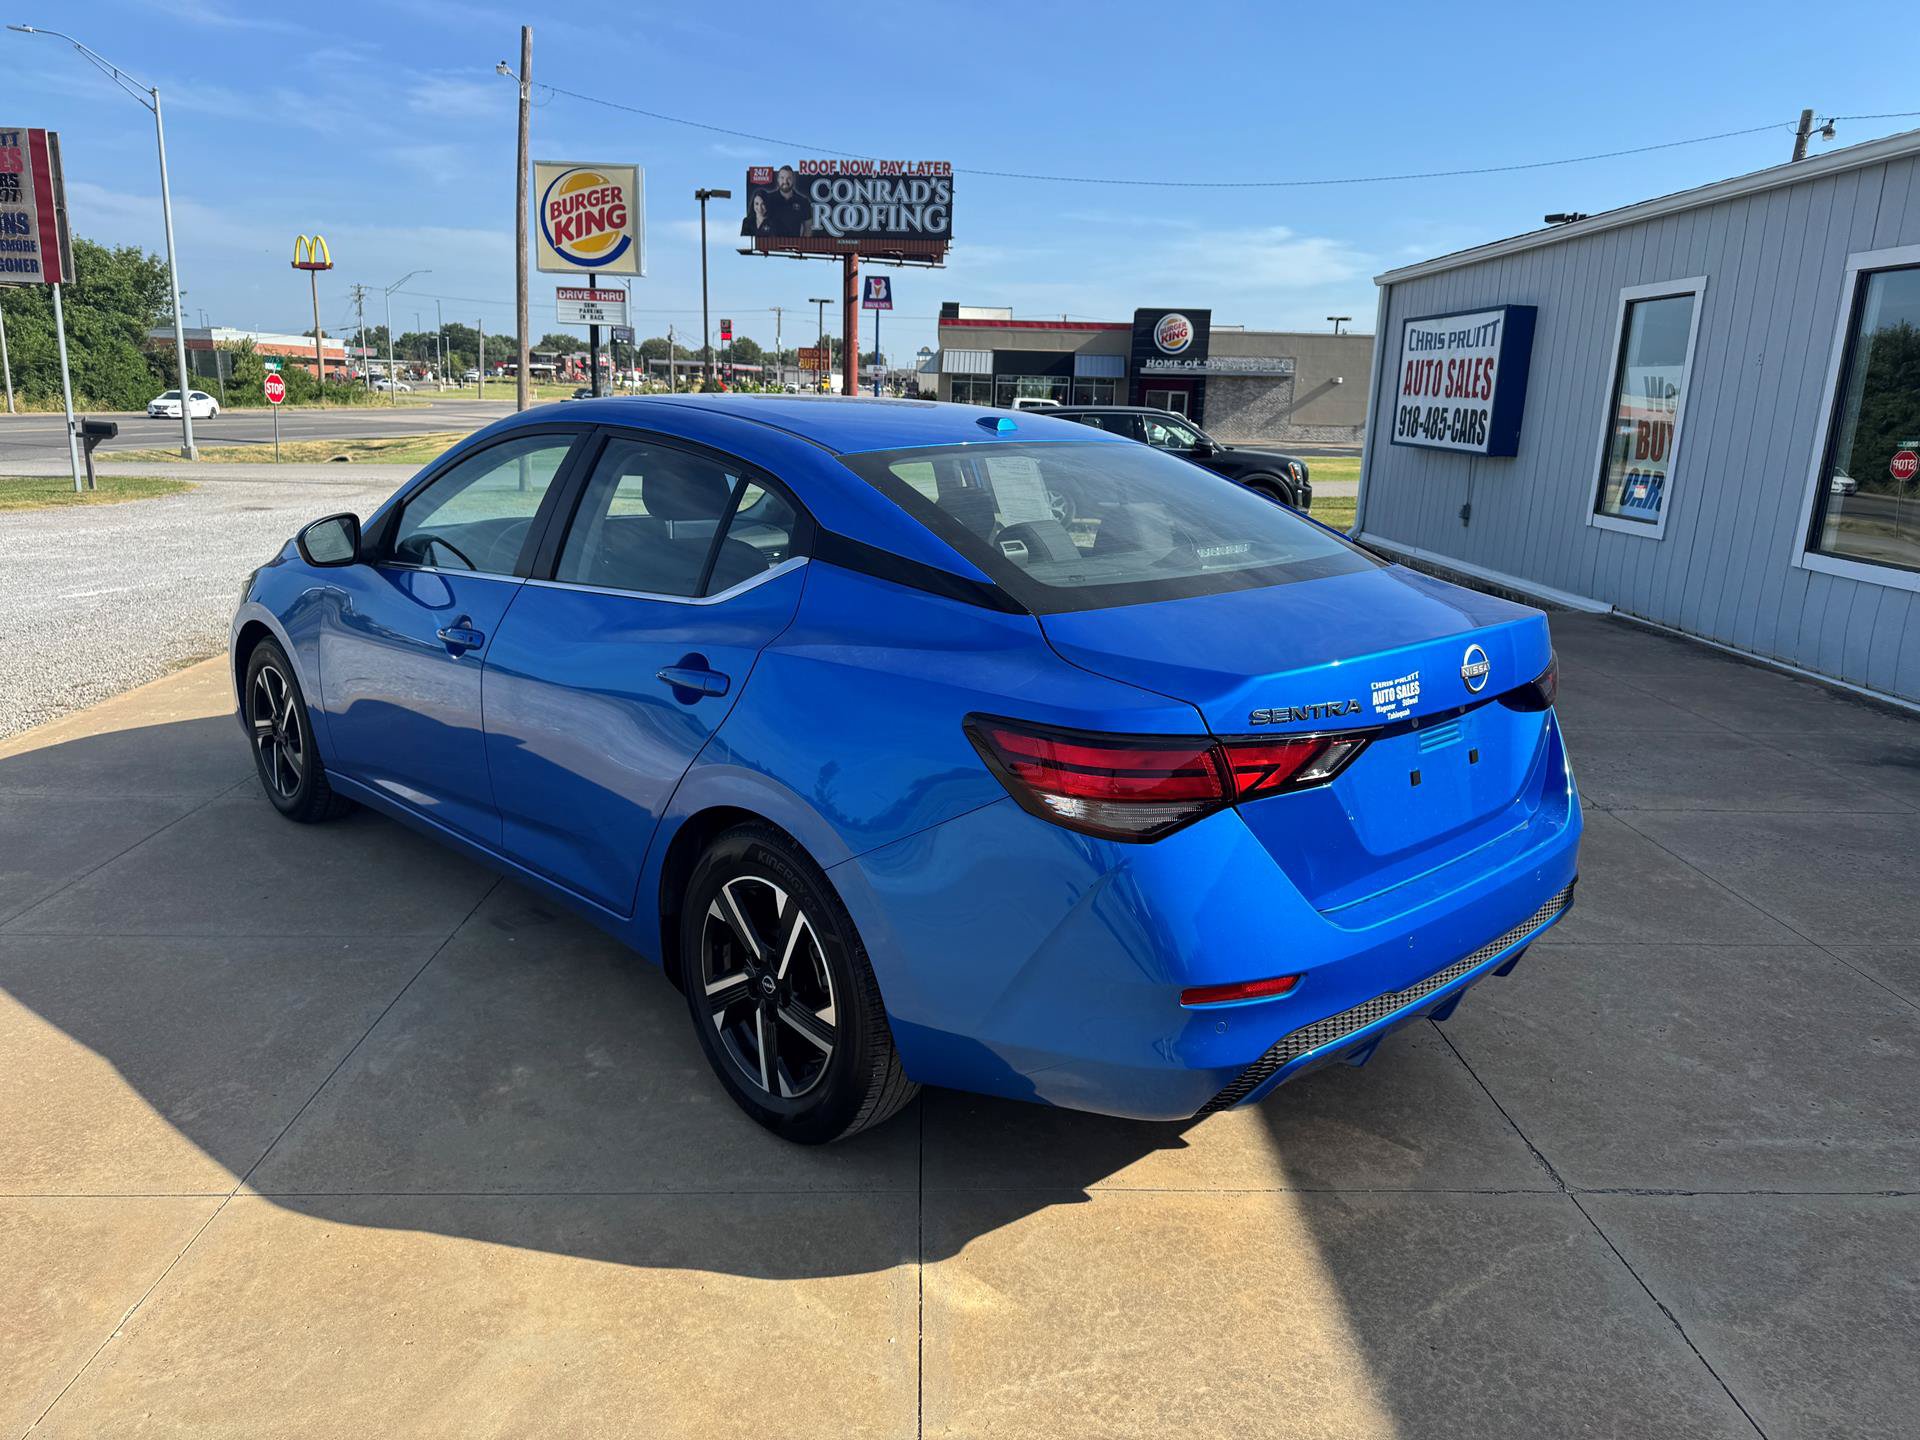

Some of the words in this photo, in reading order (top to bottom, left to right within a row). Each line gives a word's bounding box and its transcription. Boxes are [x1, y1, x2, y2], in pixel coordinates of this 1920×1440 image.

[753, 168, 769, 176] 24/7
[799, 160, 838, 175] ROOF
[839, 160, 878, 178] NOW,
[880, 160, 905, 175] PAY
[906, 160, 951, 176] LATER
[810, 177, 950, 205] CONRAD'S
[550, 186, 623, 221] BURGER
[554, 204, 627, 246] KING
[810, 202, 949, 237] ROOFING
[0, 258, 39, 273] GONER
[559, 289, 591, 300] DRIVE
[594, 291, 624, 301] THRU
[1160, 322, 1187, 335] BURGER
[1161, 328, 1188, 344] KING
[1408, 328, 1446, 351] CHRIS
[1448, 318, 1500, 349] PRUITT
[800, 358, 829, 369] BUFFT
[1145, 359, 1181, 368] HOME
[1184, 358, 1198, 368] OF
[266, 382, 284, 395] STOP
[1403, 359, 1443, 397] AUTO
[1445, 357, 1494, 400] SALES
[1643, 376, 1676, 415] We
[1399, 405, 1488, 446] 918-485-CARS
[1462, 660, 1489, 677] NISSA
[1371, 680, 1394, 690] CHRIS
[1395, 670, 1419, 684] PRUITT
[1372, 687, 1395, 705] AUTO
[1396, 681, 1420, 699] SALES
[1248, 699, 1362, 726] SENTRA
